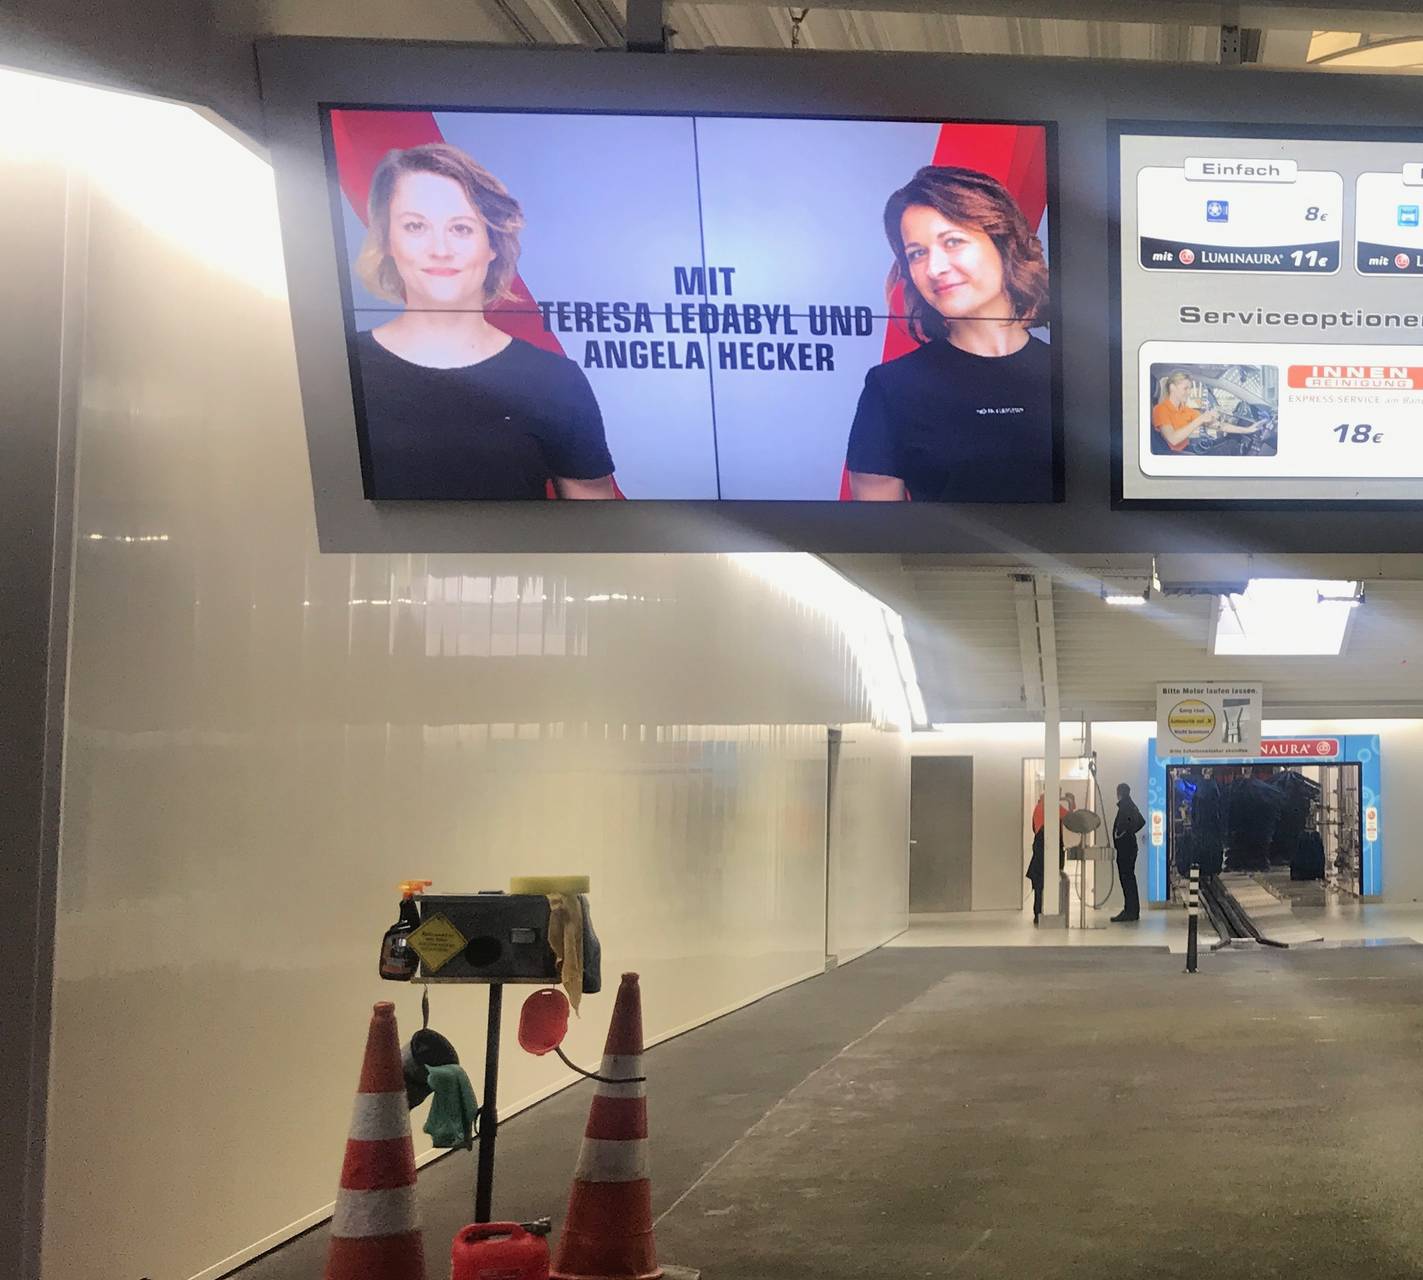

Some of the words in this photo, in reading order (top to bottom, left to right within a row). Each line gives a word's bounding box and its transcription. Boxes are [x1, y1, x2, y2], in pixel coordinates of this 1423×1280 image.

[1202, 162, 1281, 177] Einfach
[1152, 251, 1173, 263] mit
[1290, 250, 1329, 268] 11€
[1368, 256, 1389, 267] mit
[673, 266, 736, 297] MIT
[538, 300, 654, 334] TERESA
[664, 301, 800, 337] LEDABYL
[808, 305, 873, 337] UND
[583, 340, 705, 370] ANGELA
[719, 341, 835, 372] HECKER
[1311, 366, 1409, 379] INNEN
[1311, 378, 1407, 388] REINIGUNG
[1333, 423, 1384, 444] 18€
[1261, 743, 1310, 755] NAURA
